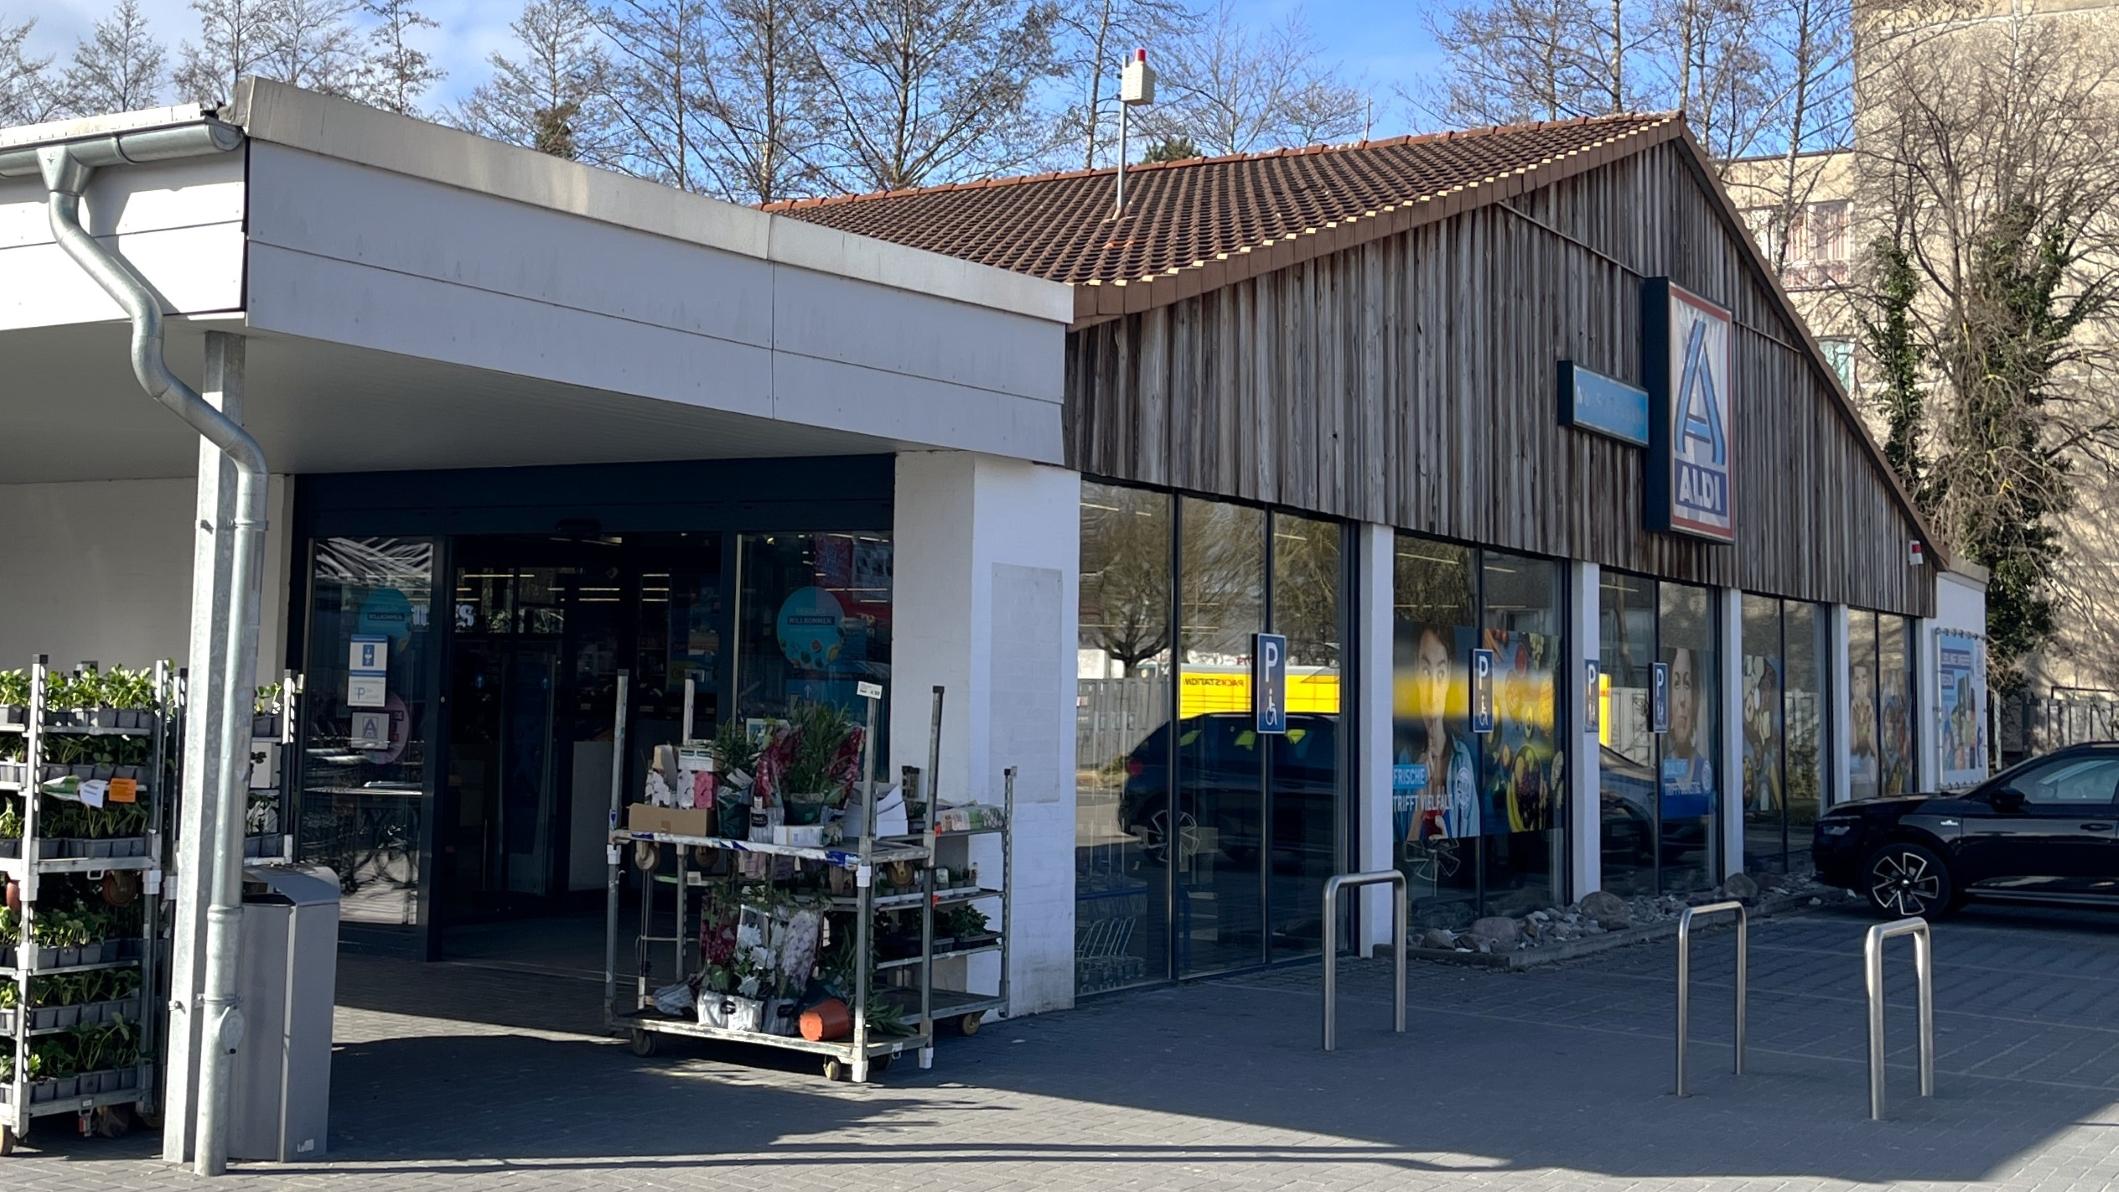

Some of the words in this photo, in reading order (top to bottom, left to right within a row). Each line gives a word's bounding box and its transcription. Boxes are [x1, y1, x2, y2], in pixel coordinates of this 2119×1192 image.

[1679, 465, 1721, 511] ALDI
[1265, 641, 1278, 683] P
[1479, 655, 1489, 690] P
[1588, 663, 1597, 696] P
[1656, 668, 1664, 697] P
[1393, 768, 1425, 785] FRISCHE
[1392, 795, 1420, 812] TRIFFT
